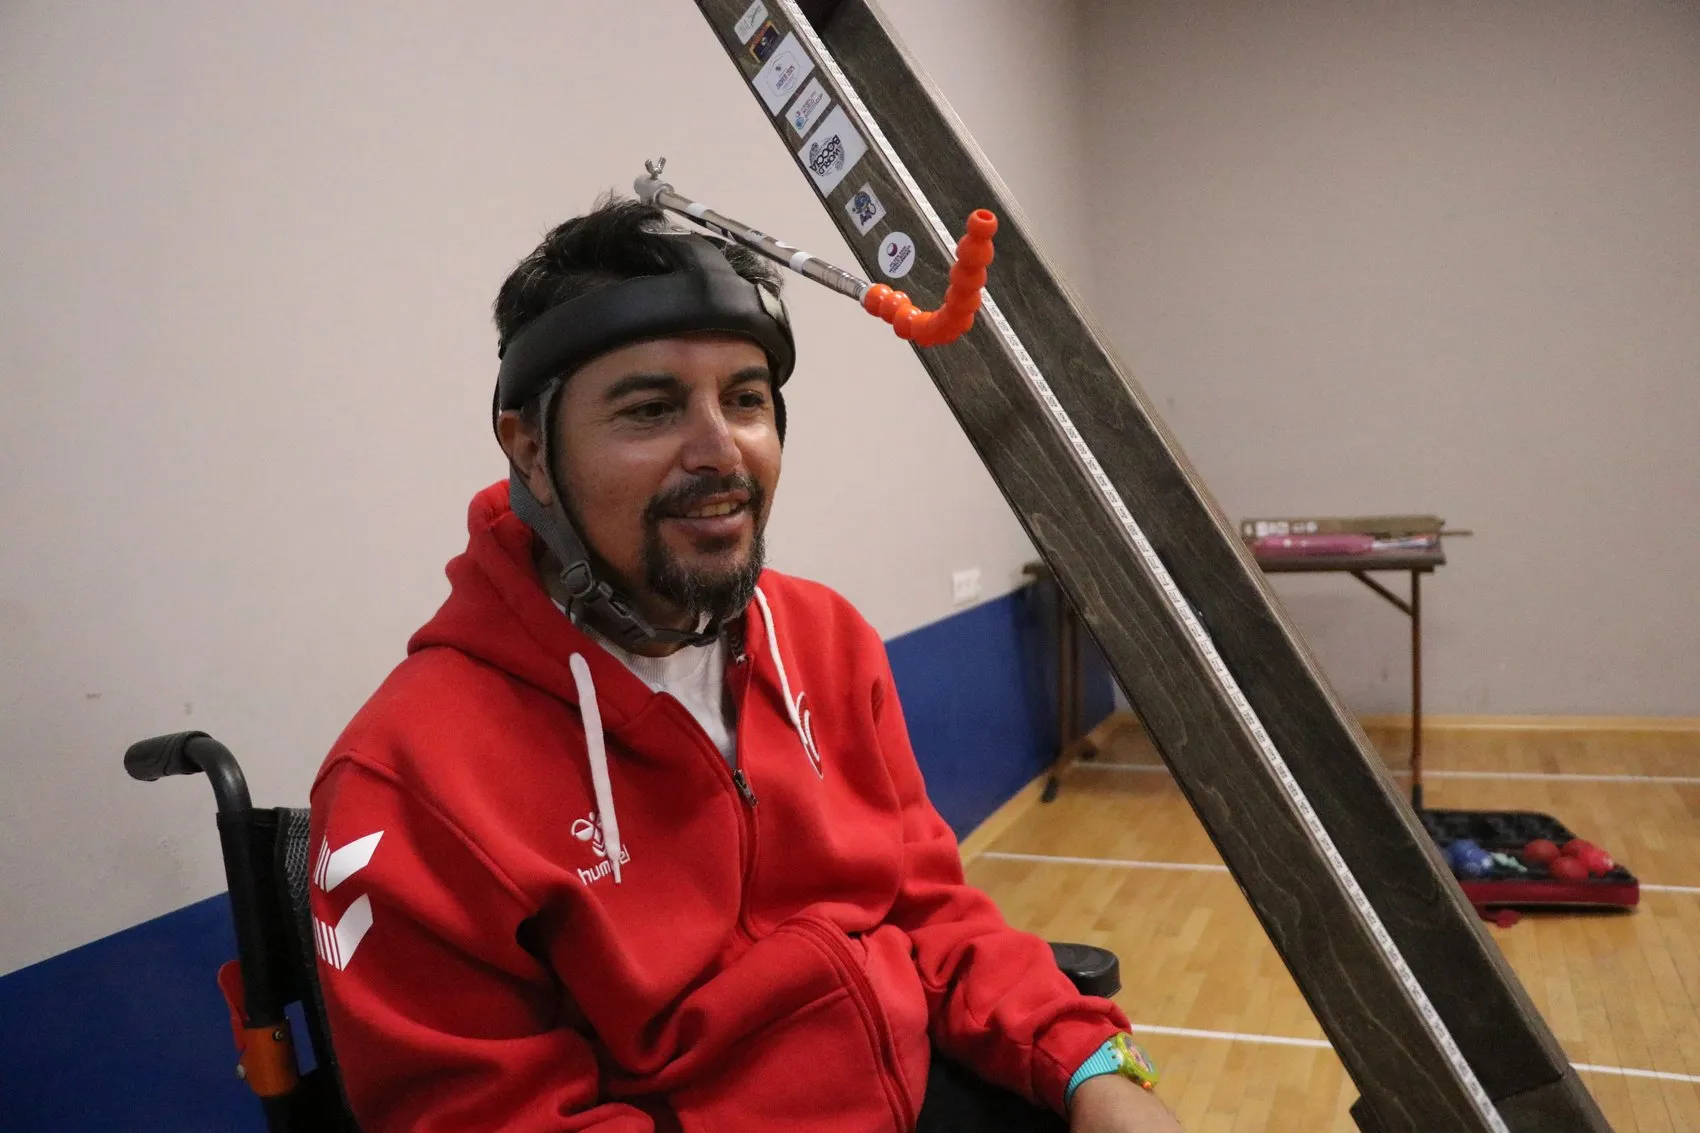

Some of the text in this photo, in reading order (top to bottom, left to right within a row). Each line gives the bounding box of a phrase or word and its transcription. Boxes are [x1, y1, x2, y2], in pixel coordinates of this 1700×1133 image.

[809, 134, 841, 172] BOCCIA
[817, 147, 841, 175] WORLD
[577, 844, 631, 886] humel
